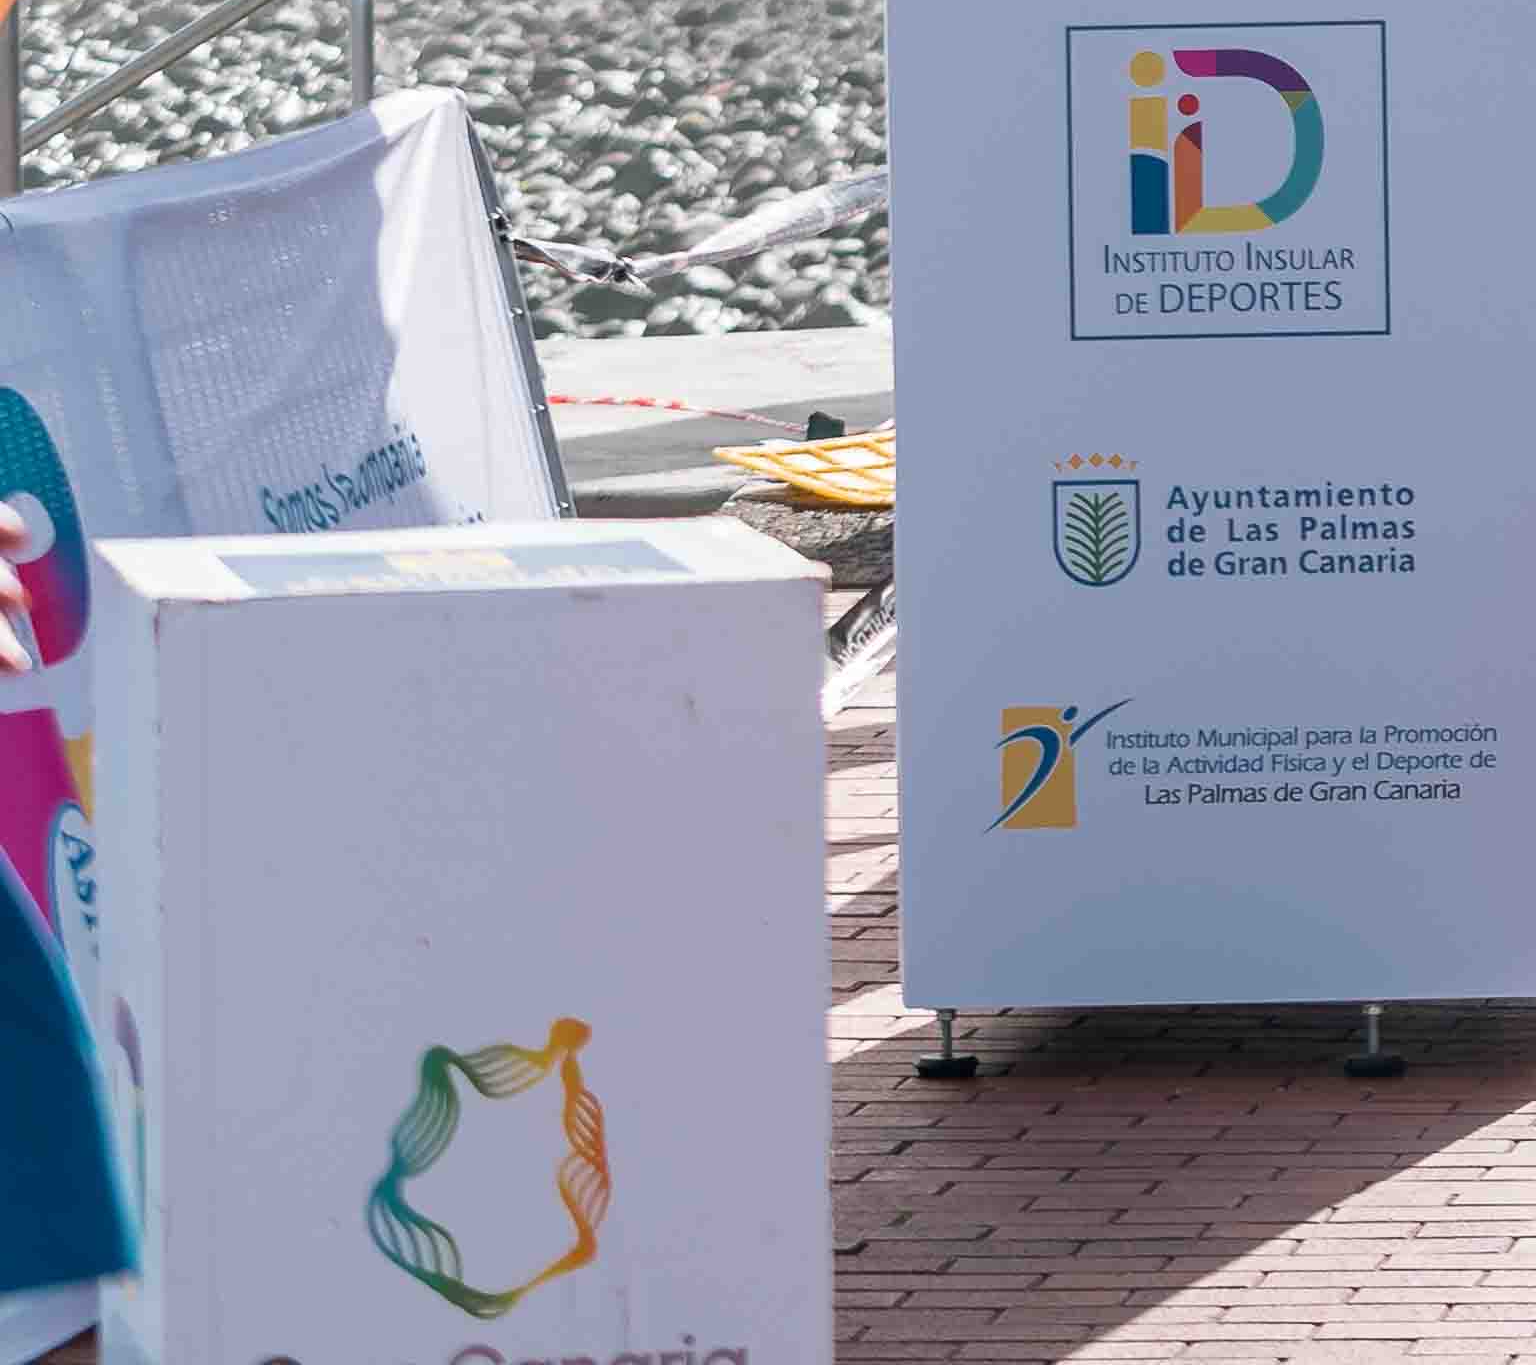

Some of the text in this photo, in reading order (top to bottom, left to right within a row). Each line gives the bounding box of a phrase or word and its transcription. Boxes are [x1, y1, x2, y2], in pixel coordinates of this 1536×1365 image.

[1166, 482, 1415, 516] Ayuntamiento
[1167, 515, 1415, 544] de Las Palmas
[1167, 550, 1415, 577] de Gran Canaria
[1106, 723, 1497, 753] Instituto Municipal para la Promoción
[1108, 750, 1497, 779] de la Actividad Física y el Deporte de
[1144, 778, 1461, 806] Las Palmas de Gran Canaria
